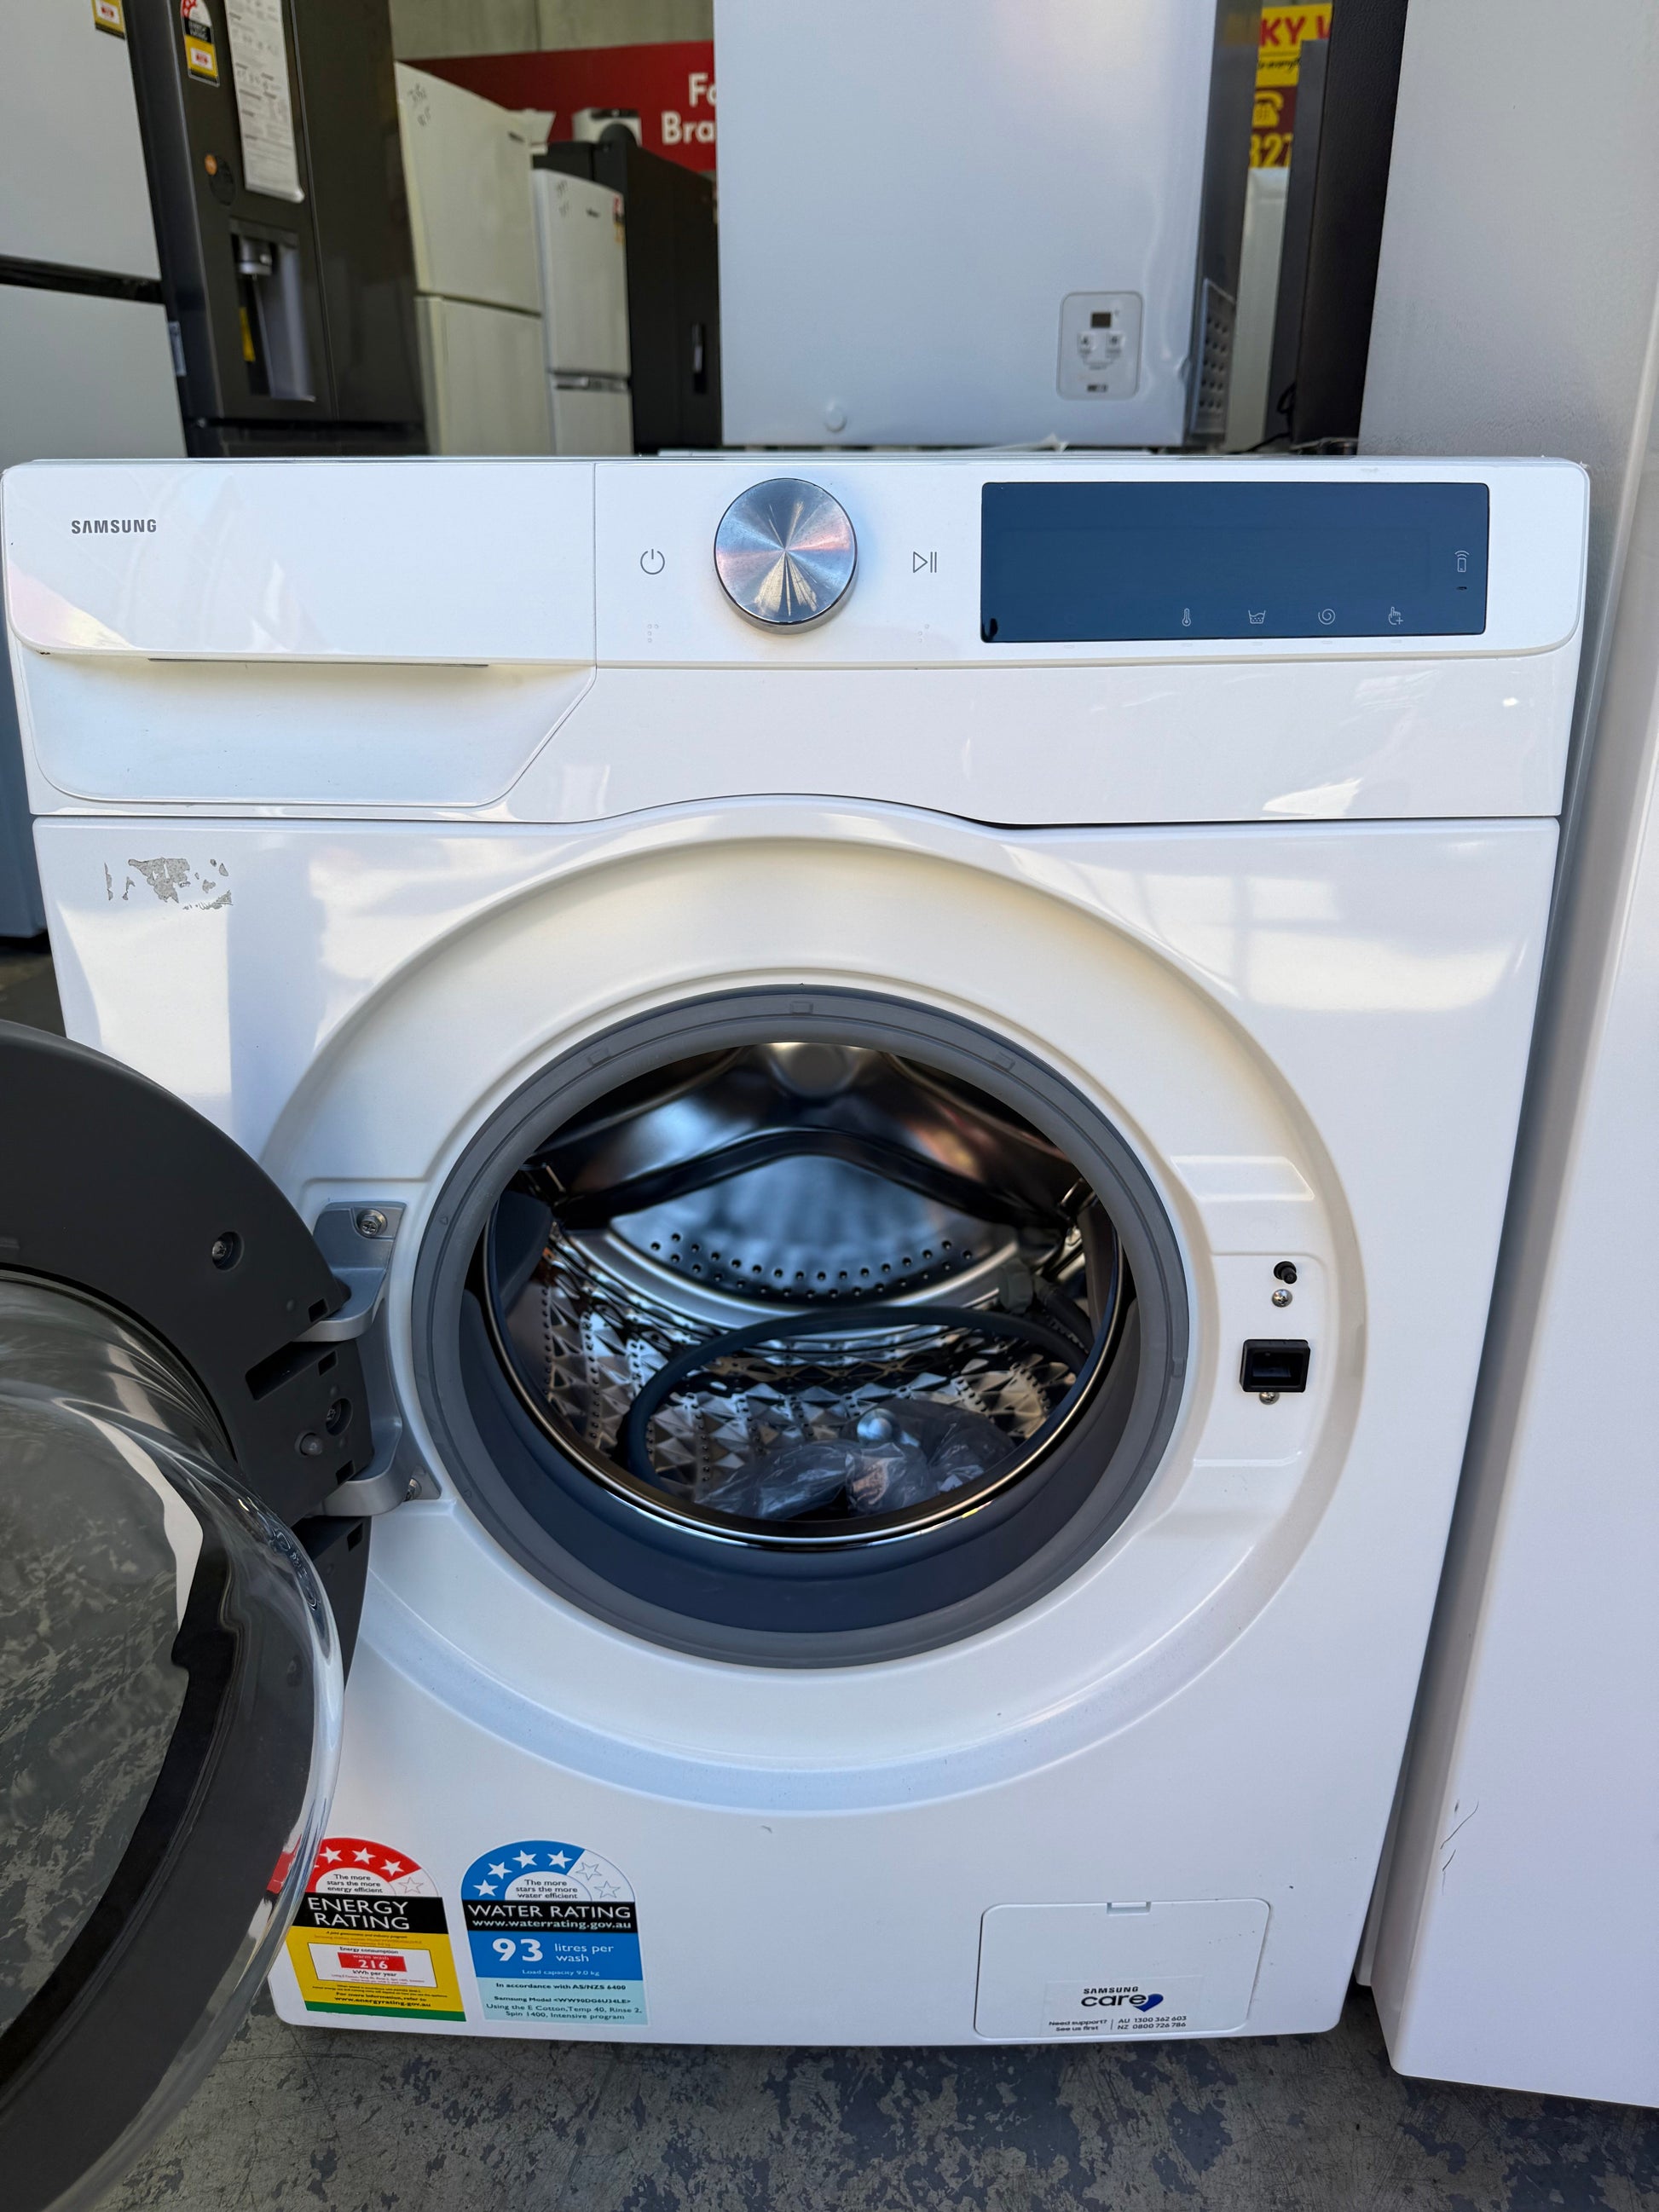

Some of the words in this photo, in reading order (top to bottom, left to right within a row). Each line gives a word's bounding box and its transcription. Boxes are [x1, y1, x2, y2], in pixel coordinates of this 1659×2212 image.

[71, 519, 157, 534] SAMSUNG
[308, 1897, 408, 1915] ENERGY
[468, 1904, 543, 1918] WATER
[551, 1906, 631, 1918] RATING
[314, 1913, 409, 1930] RATING
[472, 1920, 631, 1930] www.waterrating.gov.au
[492, 1938, 543, 1961] 93
[554, 1943, 587, 1952] litres
[592, 1945, 614, 1955] per
[358, 1960, 388, 1969] 216
[334, 1996, 431, 2007] www.energyrating.gov.au
[1081, 1994, 1147, 2007] care
